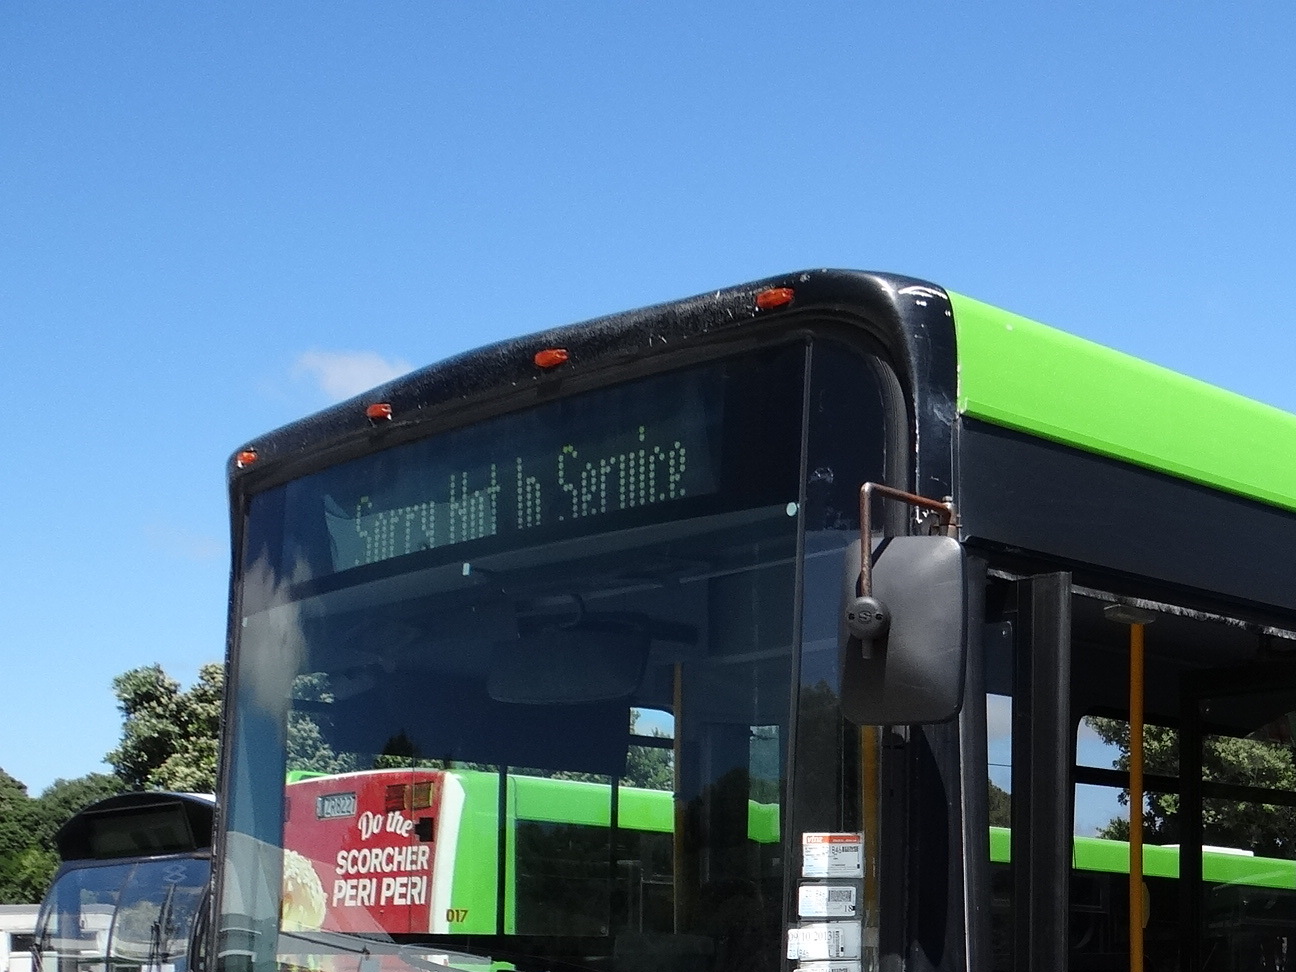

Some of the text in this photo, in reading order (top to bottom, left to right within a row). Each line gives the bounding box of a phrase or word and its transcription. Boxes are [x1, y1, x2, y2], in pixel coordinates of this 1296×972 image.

[358, 811, 413, 840] Do the
[336, 845, 430, 875] SCORCHER
[332, 876, 427, 907] PERI PERI
[446, 908, 468, 923] 017
